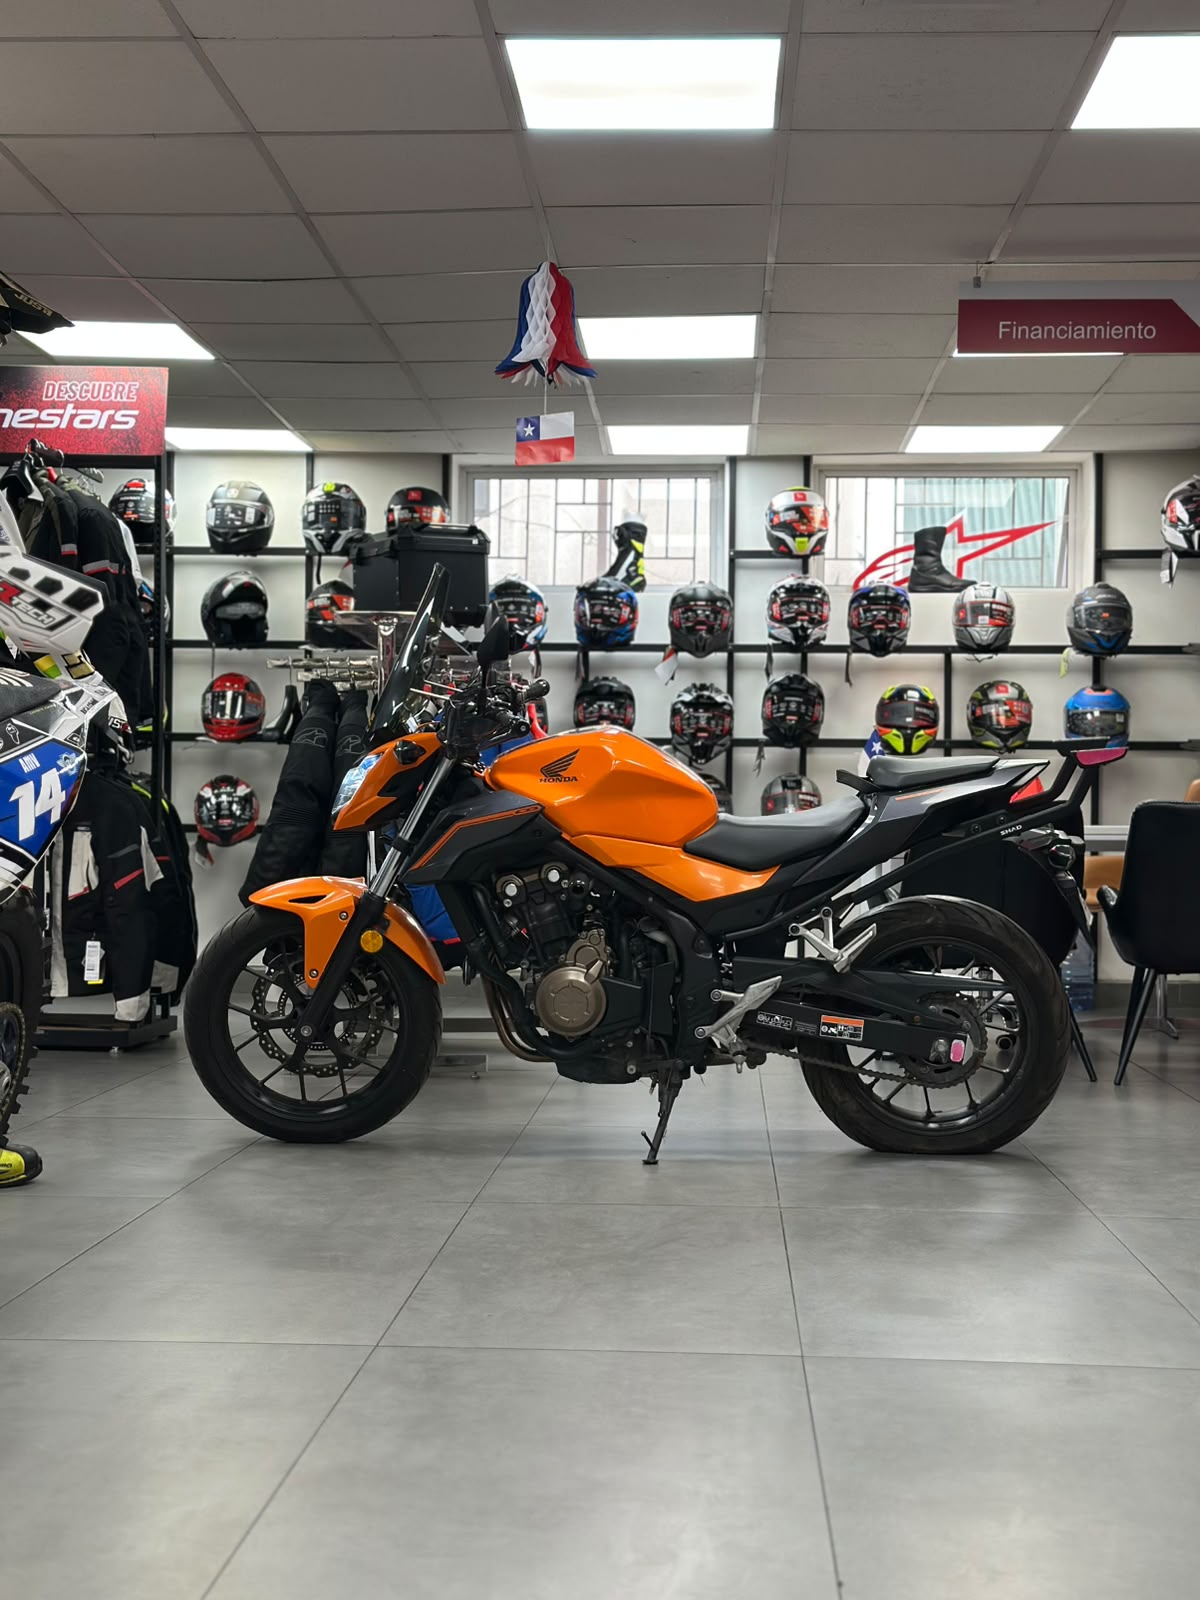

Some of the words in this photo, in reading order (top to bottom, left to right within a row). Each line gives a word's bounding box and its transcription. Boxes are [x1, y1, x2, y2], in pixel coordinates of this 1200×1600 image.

[998, 321, 1157, 340] Financiamiento
[42, 381, 140, 402] DESCUBRE
[8, 767, 67, 841] 14
[1000, 825, 1023, 836] SHAD
